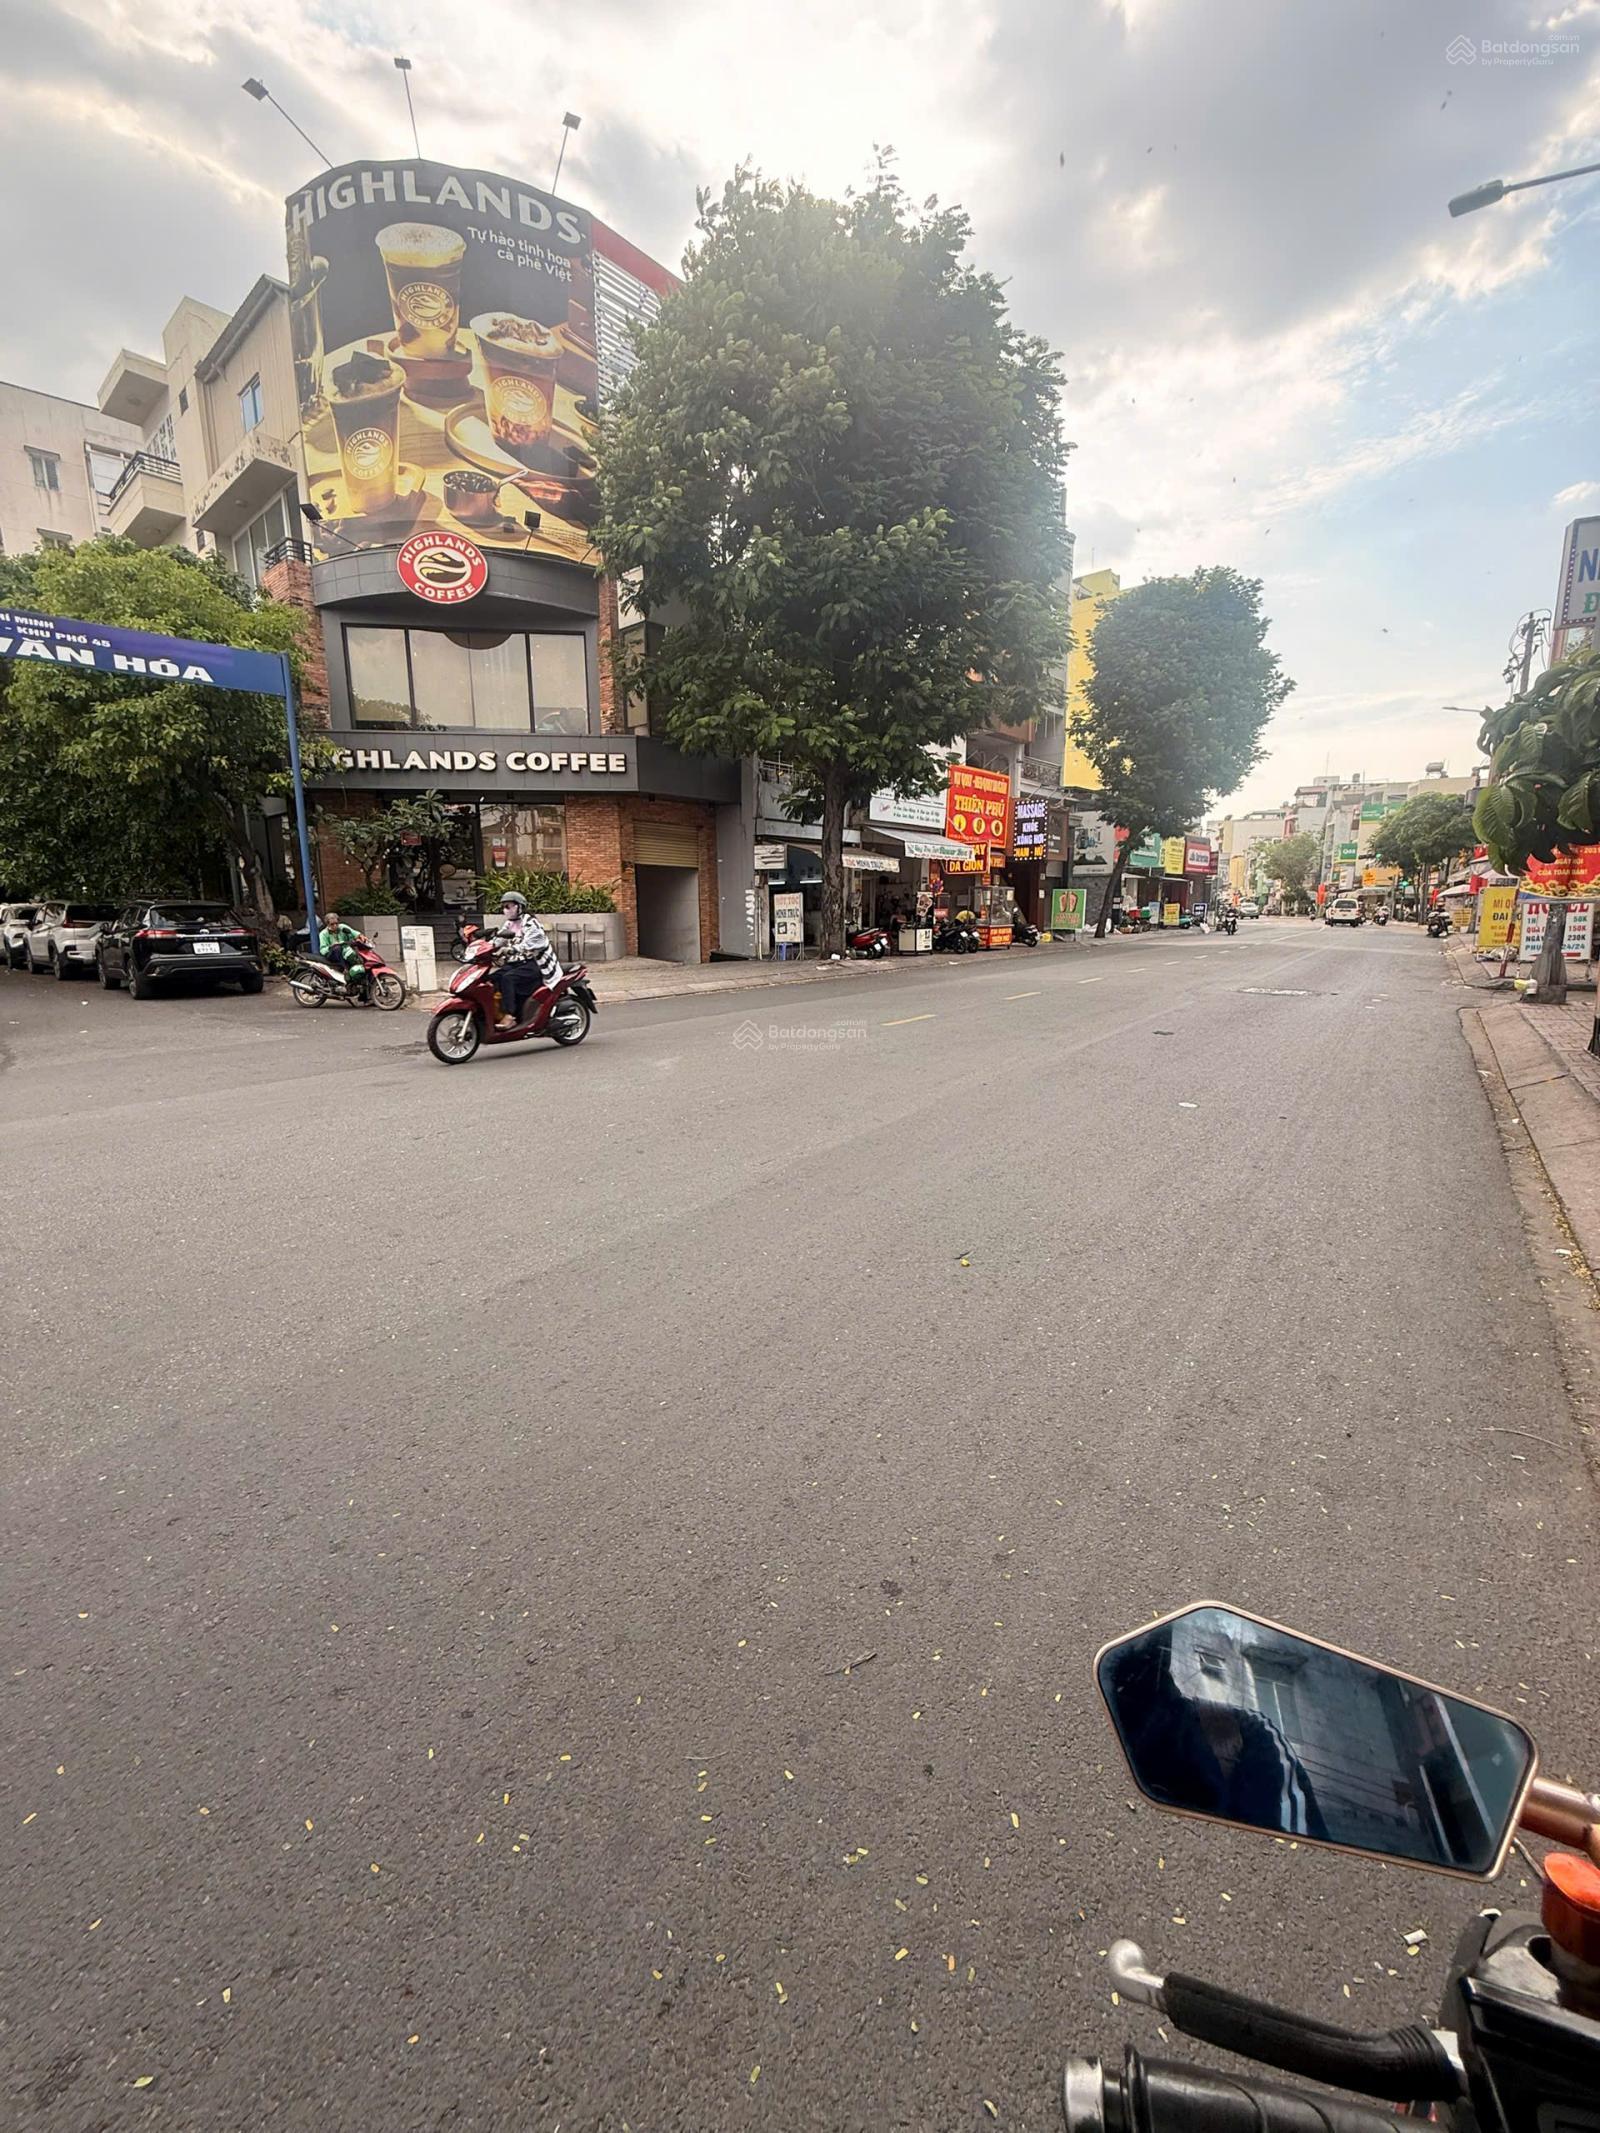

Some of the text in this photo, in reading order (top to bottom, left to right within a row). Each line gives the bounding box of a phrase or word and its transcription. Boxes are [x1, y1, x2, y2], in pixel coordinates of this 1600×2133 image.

[291, 170, 583, 245] HIGHLANDS
[467, 226, 487, 245] Tự
[489, 230, 515, 250] hào
[546, 245, 573, 270] hoa
[516, 253, 543, 276] phê
[544, 262, 573, 284] Việt
[402, 535, 482, 567] HIGHLANDS
[1578, 548, 1600, 582] N
[414, 582, 476, 599] COFFEE
[14, 615, 54, 629] MINH
[16, 626, 51, 638] KHU
[55, 632, 87, 645] PHỐ
[92, 639, 111, 648] 45
[113, 654, 214, 683] HÓA
[505, 751, 626, 772] COFFEE
